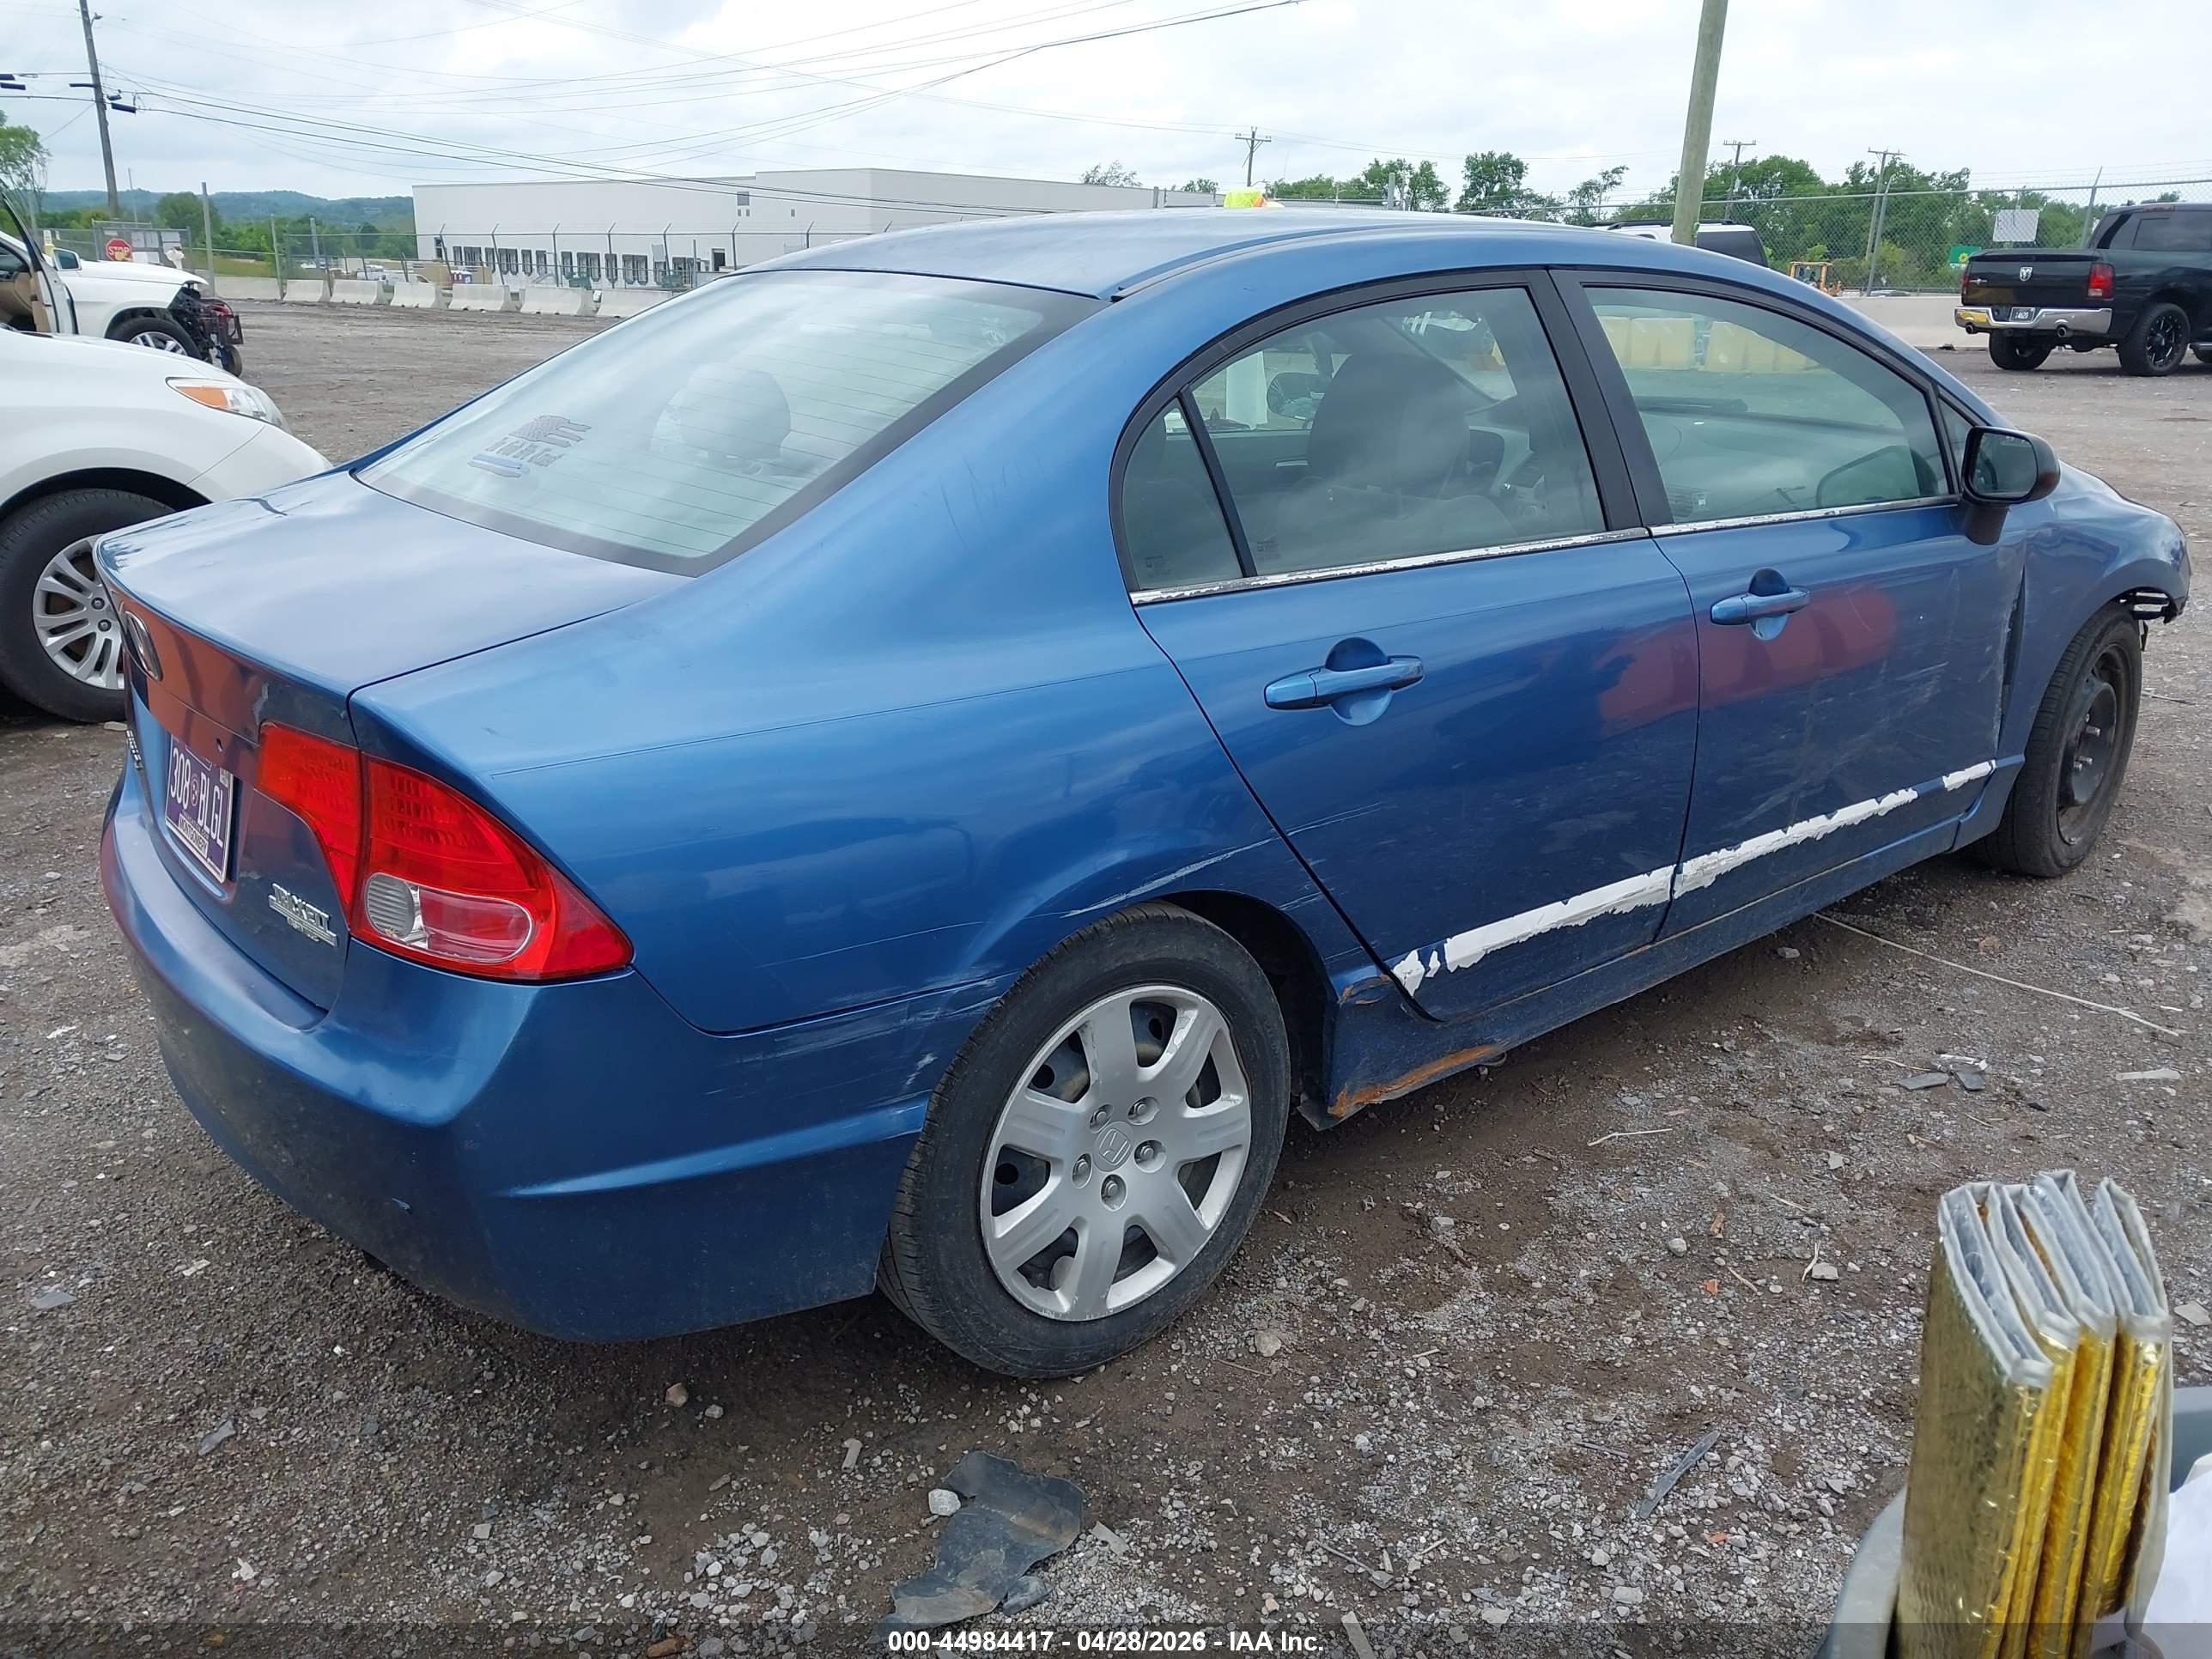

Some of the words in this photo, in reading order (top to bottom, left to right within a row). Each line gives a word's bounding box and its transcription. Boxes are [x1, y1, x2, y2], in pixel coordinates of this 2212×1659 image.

[171, 747, 191, 810] 308
[198, 772, 223, 848] BLGL
[179, 816, 207, 855] MONTGOMERY
